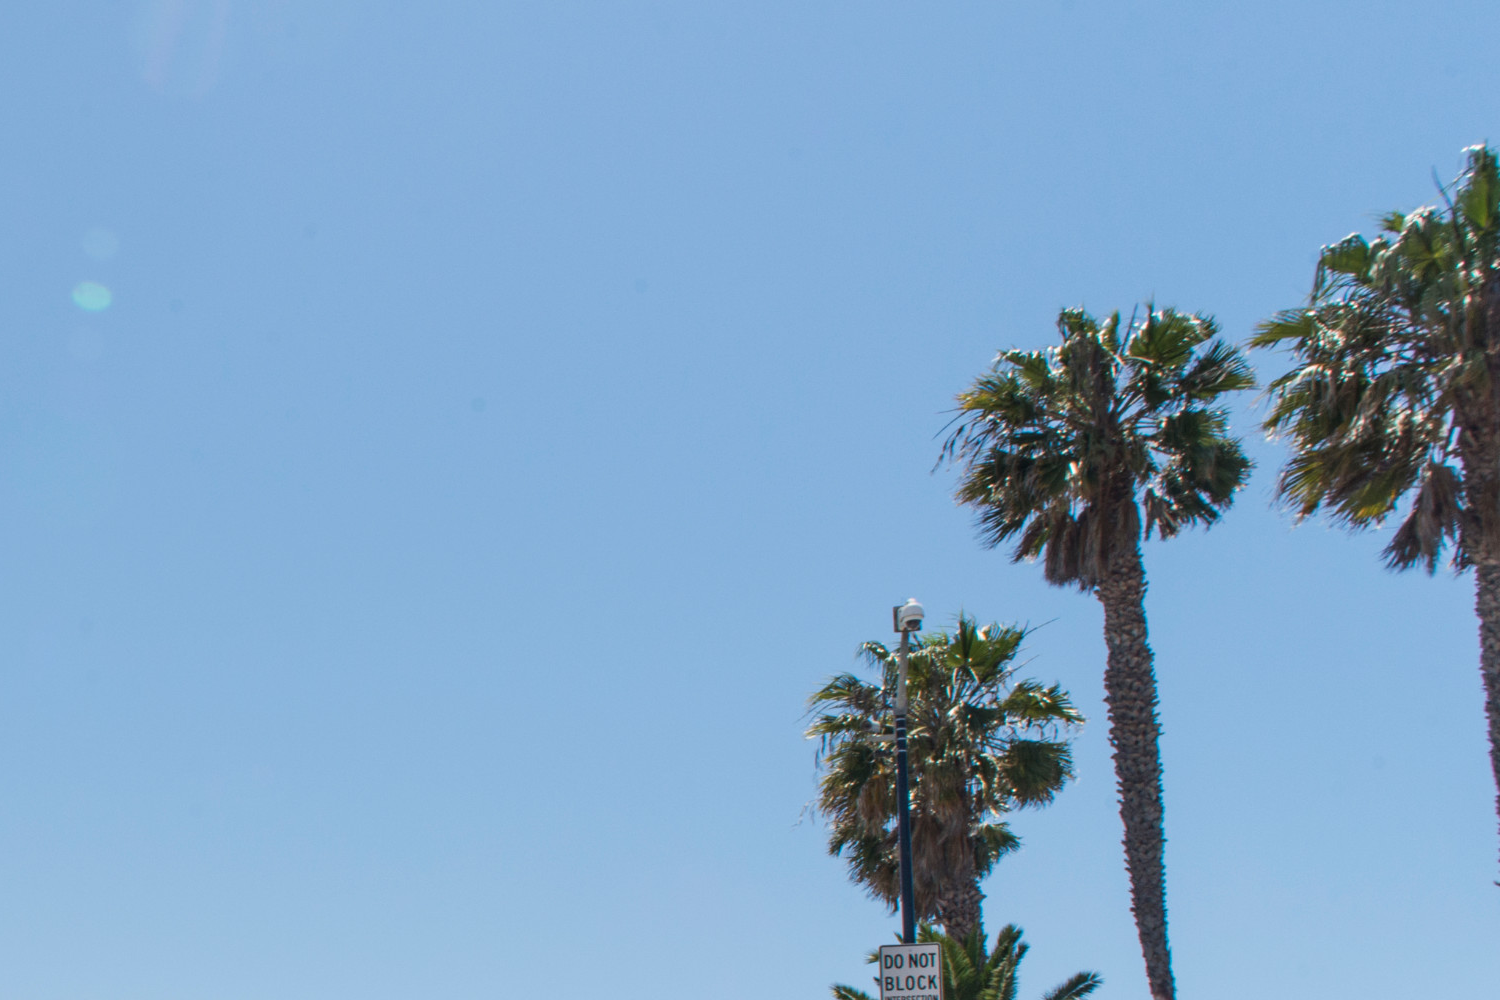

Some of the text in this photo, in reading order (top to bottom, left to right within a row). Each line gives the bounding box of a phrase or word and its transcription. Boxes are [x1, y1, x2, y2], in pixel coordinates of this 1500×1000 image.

[884, 953, 936, 969] DO NOT
[884, 975, 938, 991] BLOCK
